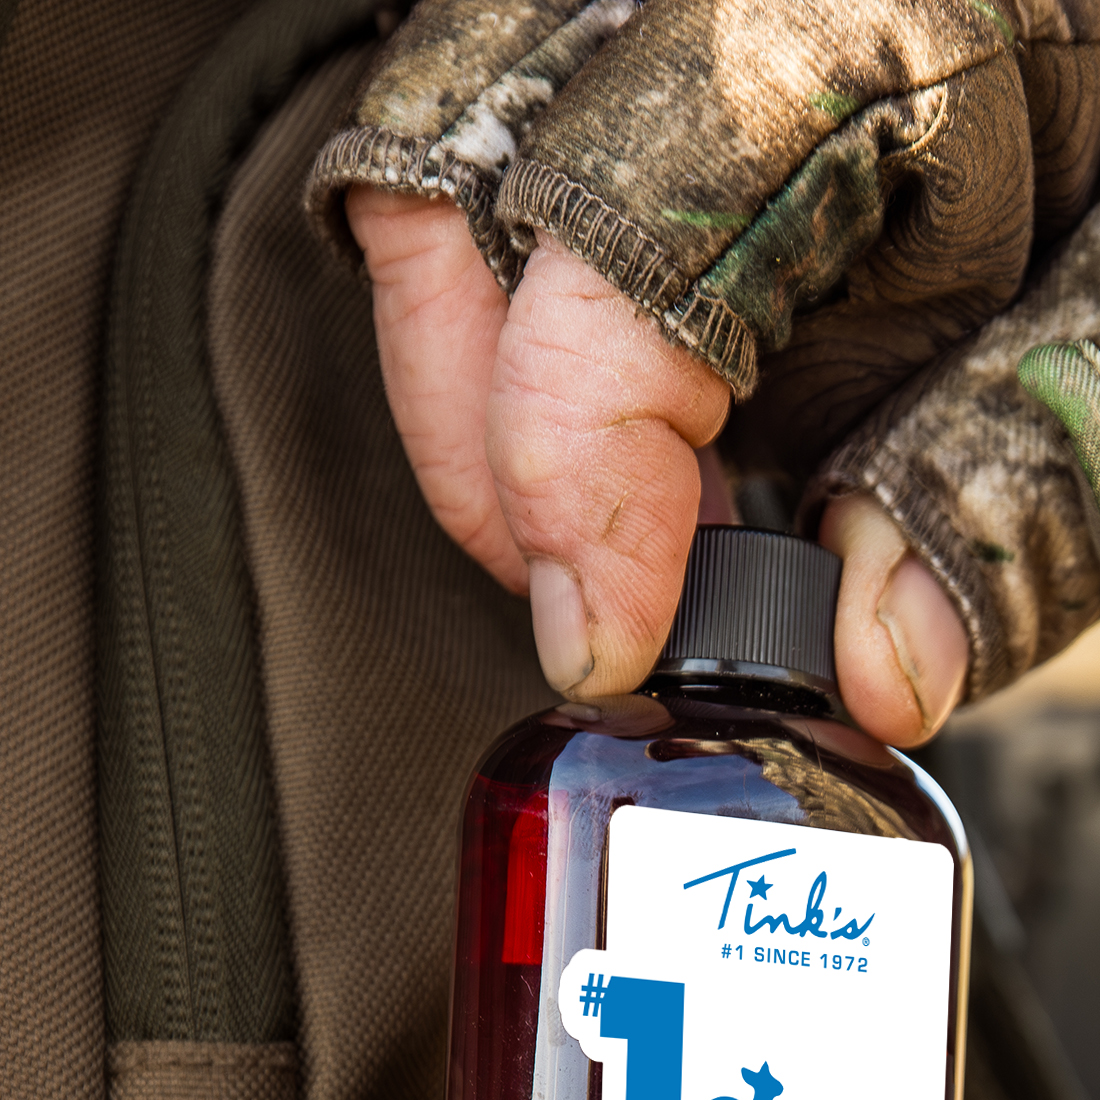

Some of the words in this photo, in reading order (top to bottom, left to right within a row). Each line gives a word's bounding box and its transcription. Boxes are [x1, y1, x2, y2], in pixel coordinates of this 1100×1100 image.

[721, 943, 743, 960] #1
[754, 946, 811, 967] SINCE
[820, 953, 868, 973] 1972
